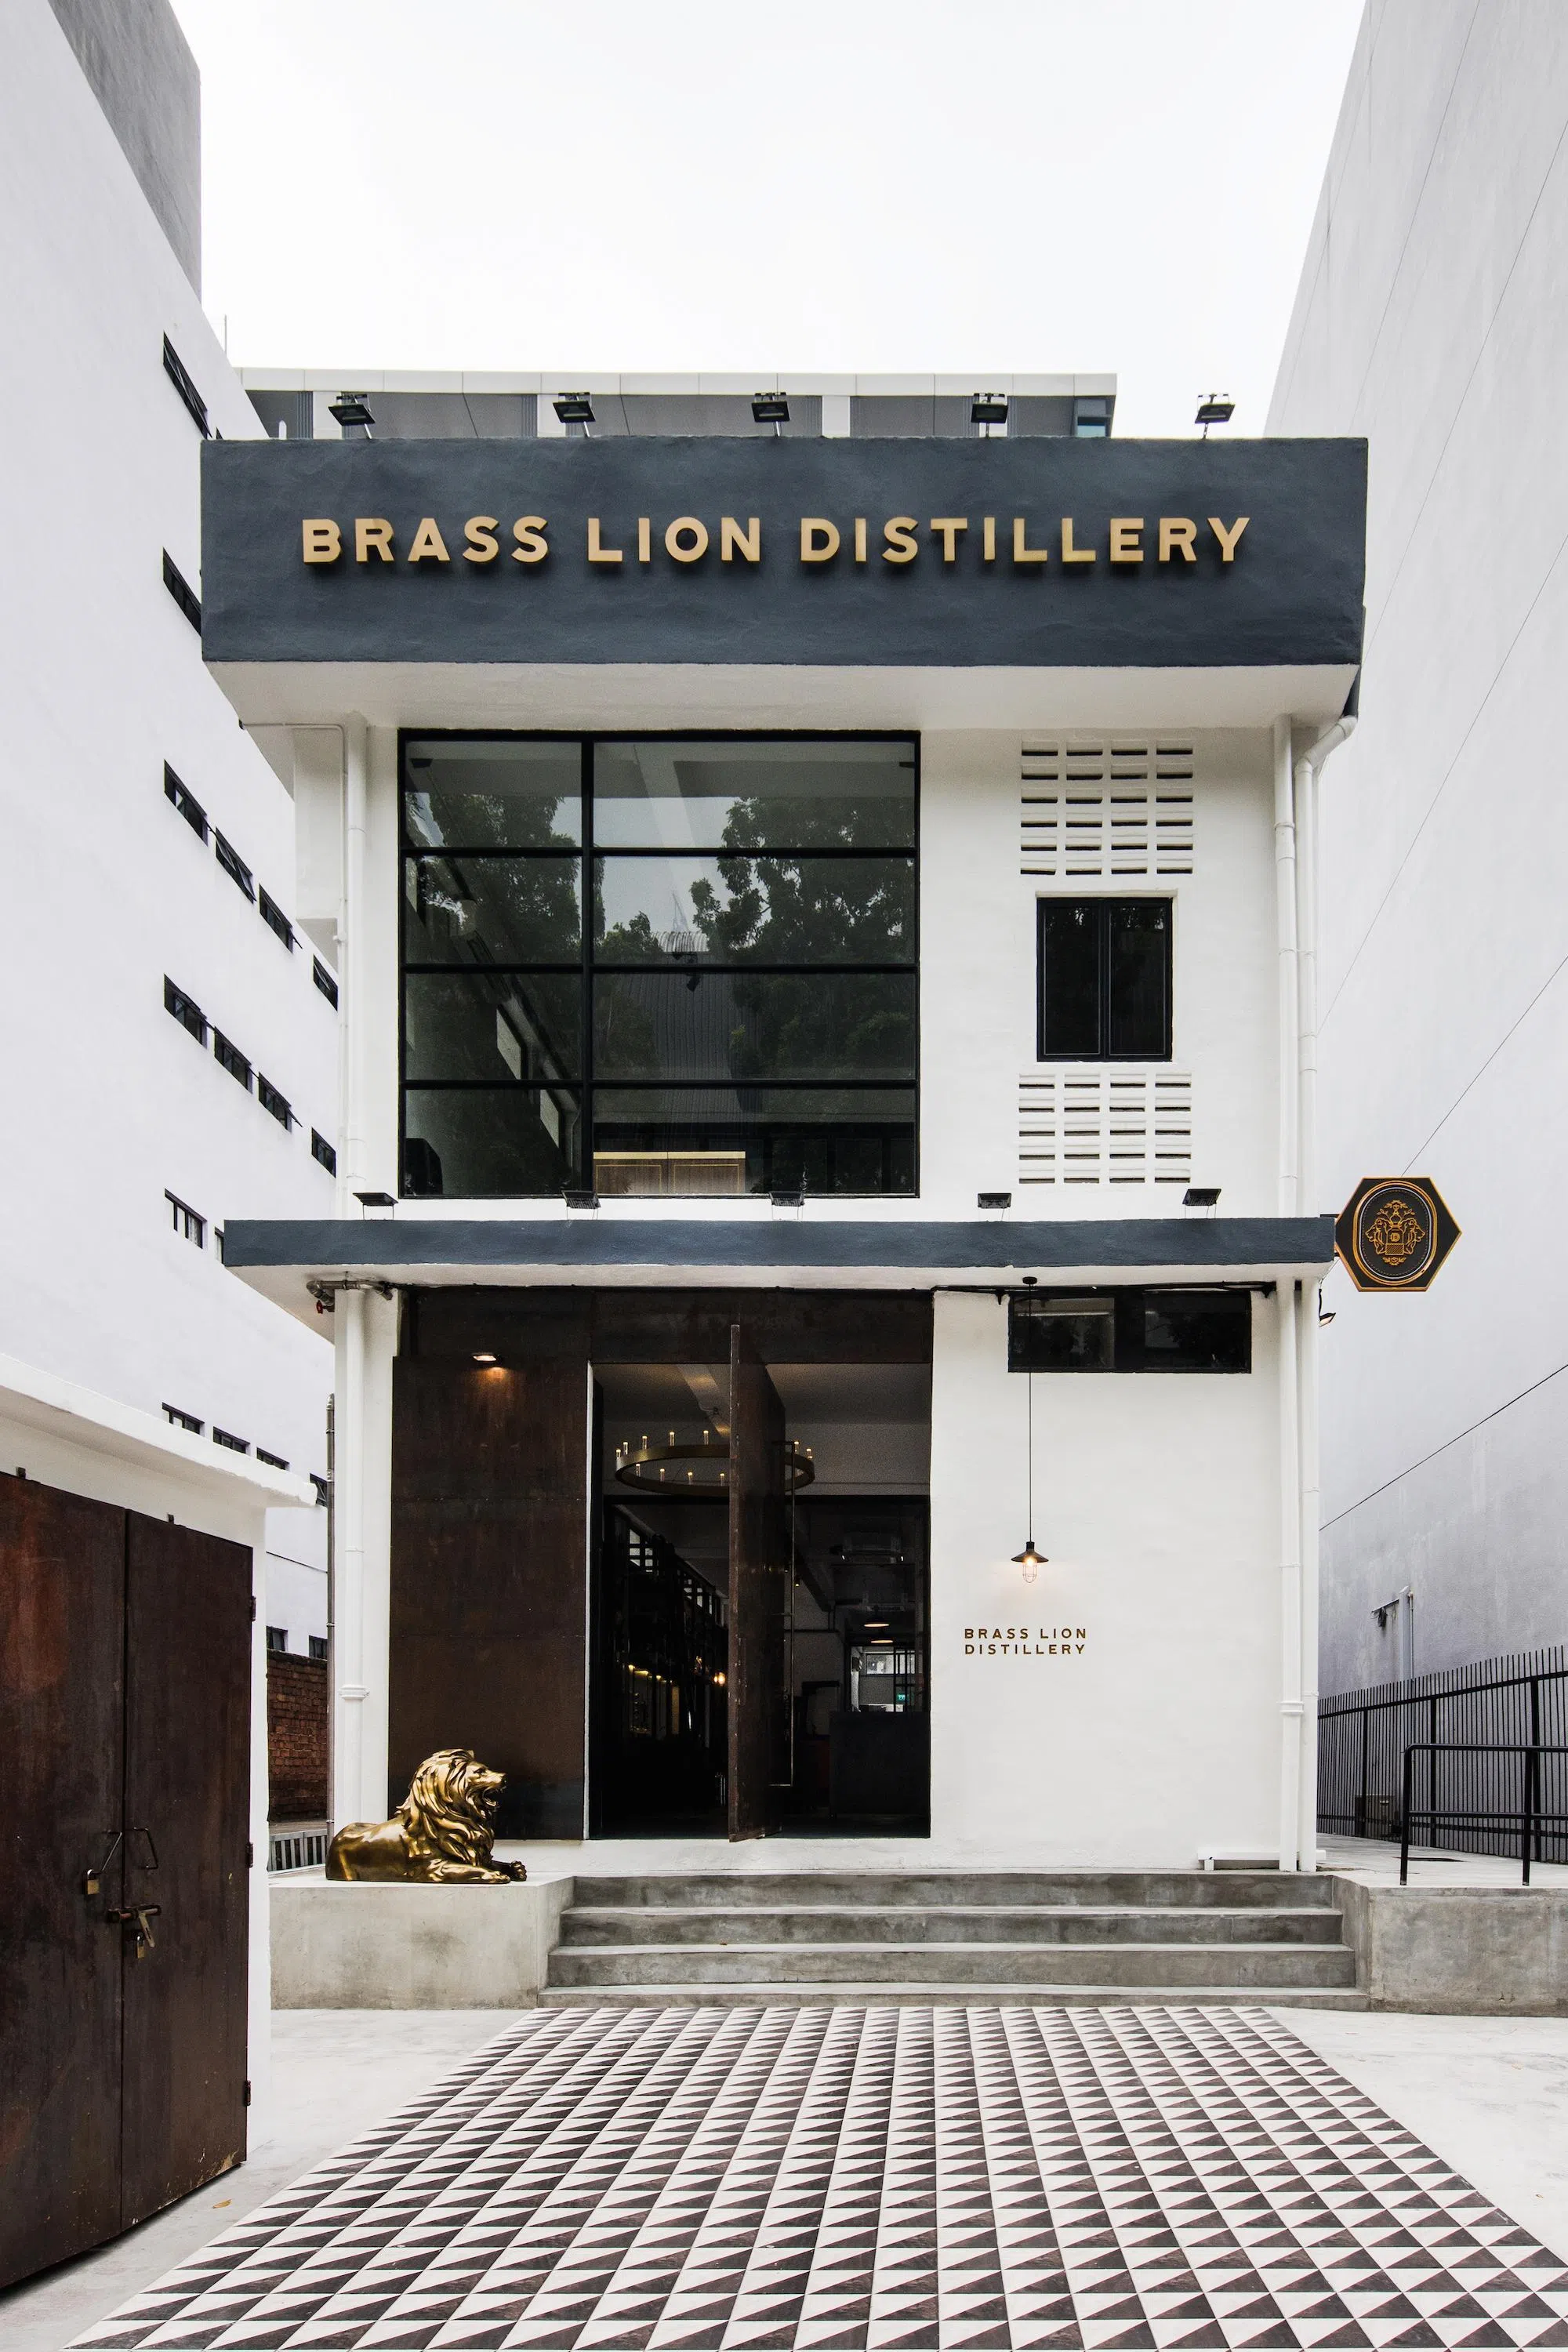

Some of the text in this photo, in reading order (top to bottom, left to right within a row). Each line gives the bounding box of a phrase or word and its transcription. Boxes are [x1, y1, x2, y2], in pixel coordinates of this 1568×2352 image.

[302, 515, 1250, 564] BRASS LION DISTILLERY
[964, 1628, 1086, 1639] BRASS LION
[964, 1643, 1085, 1655] DISTILLERY
